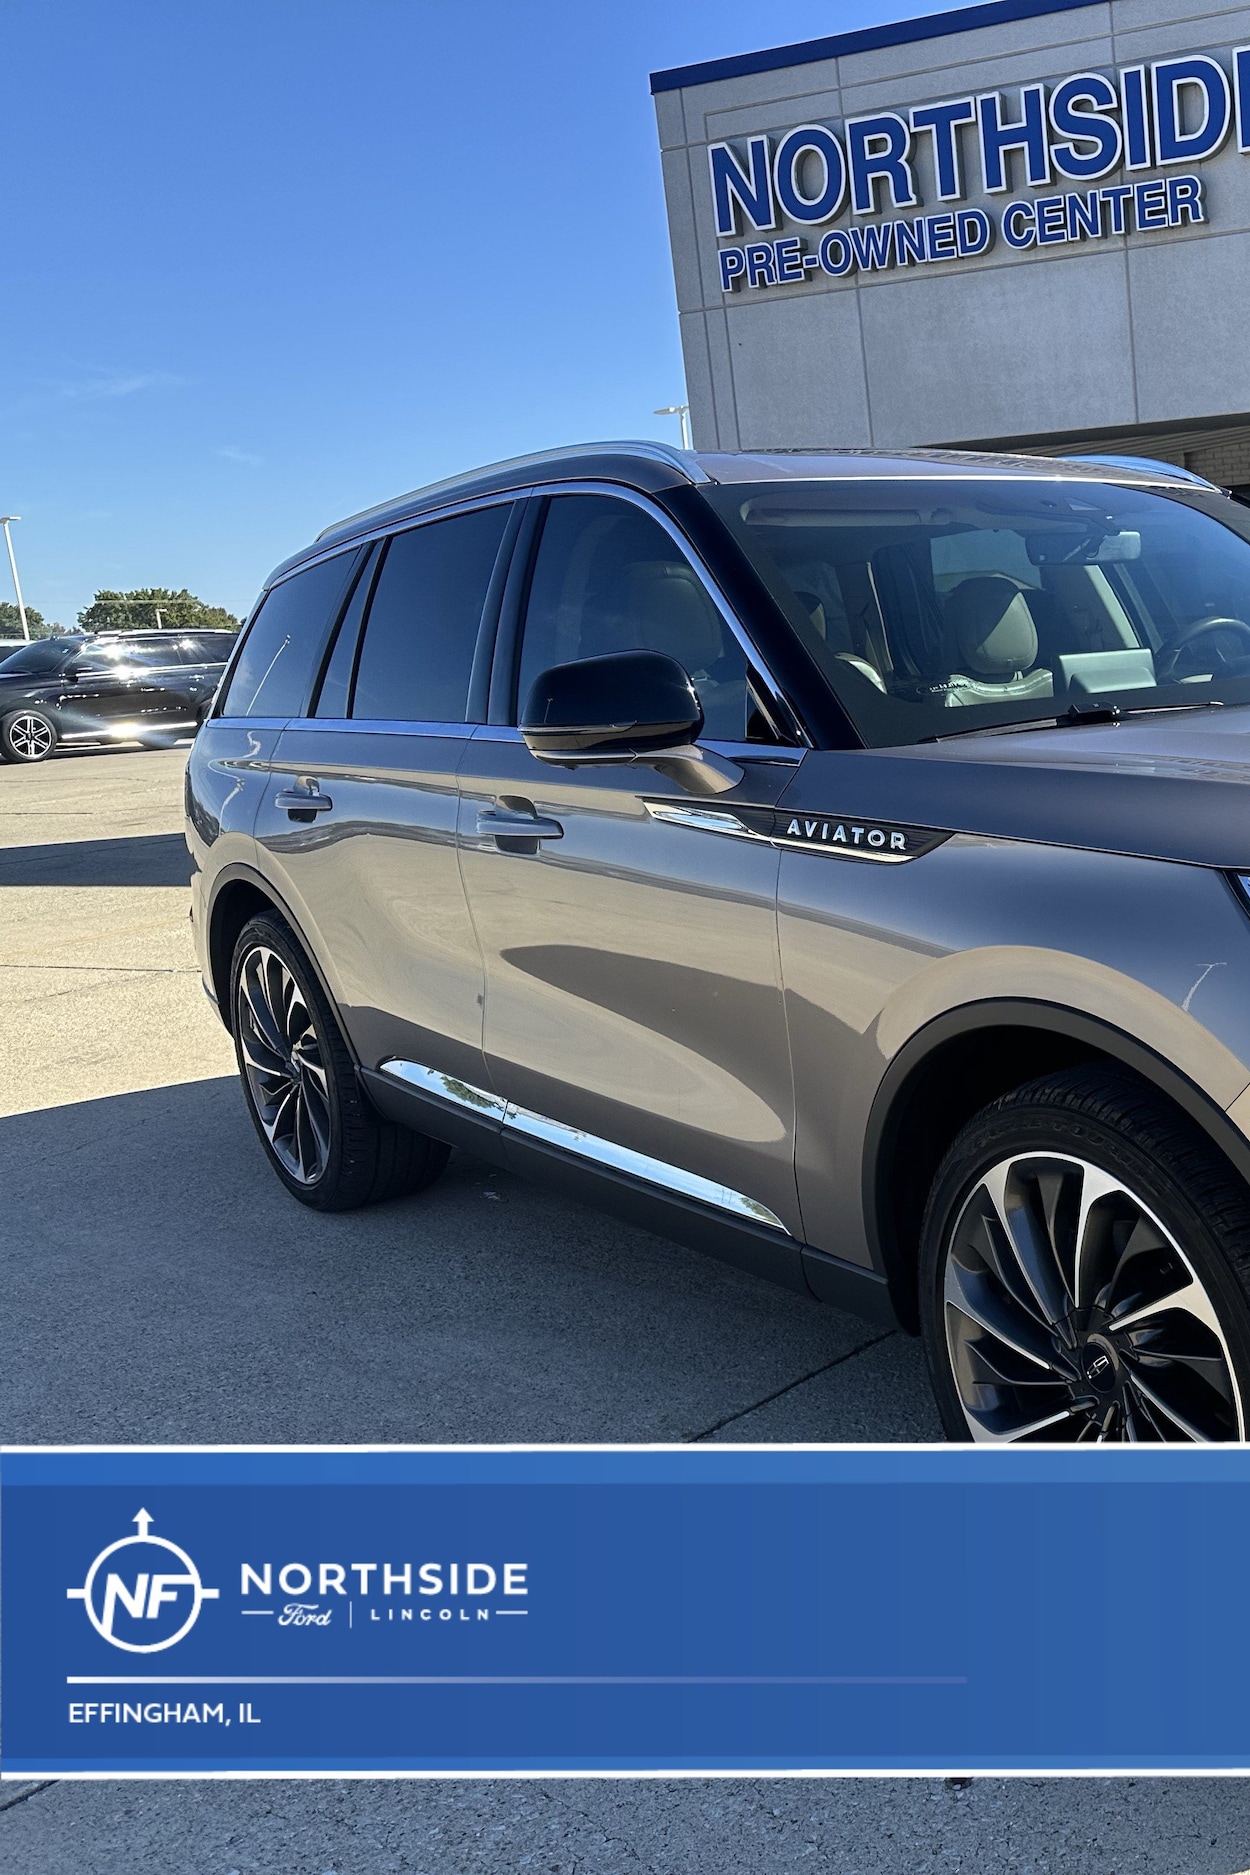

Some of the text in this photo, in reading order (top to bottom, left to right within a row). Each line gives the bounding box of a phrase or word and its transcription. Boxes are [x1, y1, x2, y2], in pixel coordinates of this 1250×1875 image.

[719, 174, 1205, 292] PRE-OWNED CENTER
[786, 818, 906, 850] AVIATOR
